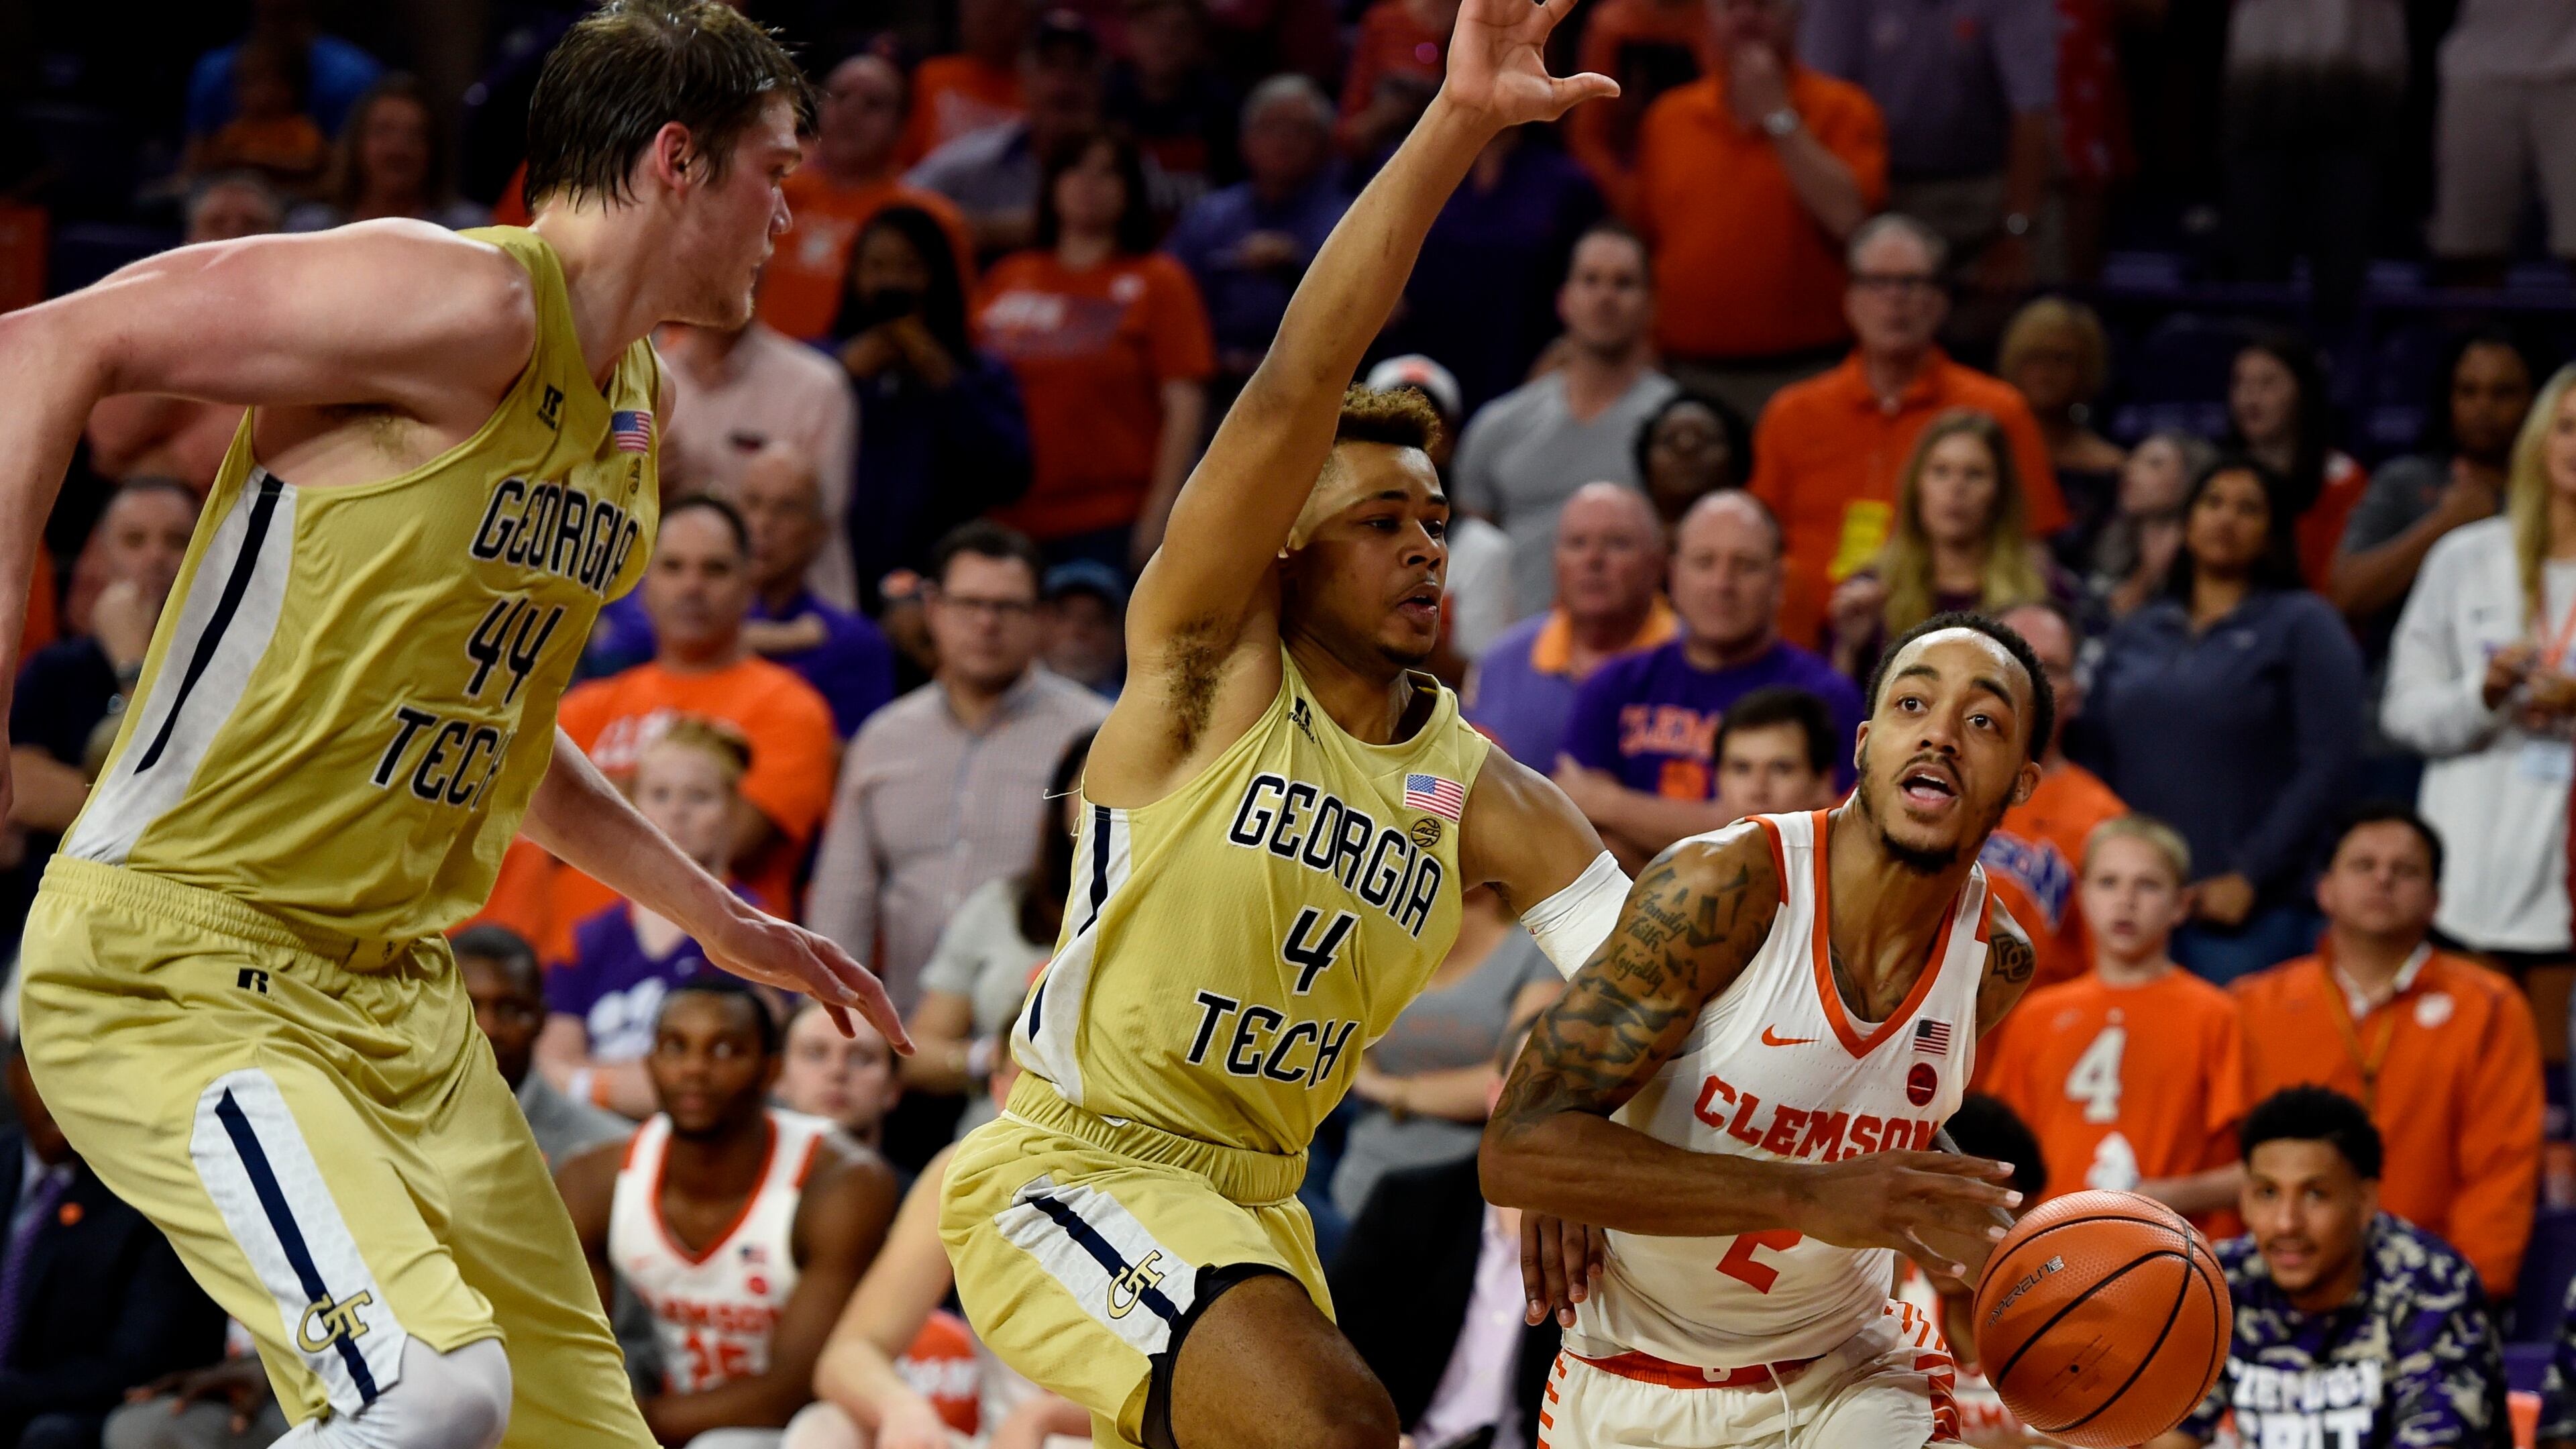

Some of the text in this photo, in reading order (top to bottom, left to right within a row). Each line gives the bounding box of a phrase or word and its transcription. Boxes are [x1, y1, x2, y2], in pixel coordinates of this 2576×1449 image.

[468, 477, 639, 598] GEORGIA
[465, 594, 567, 709] 44
[1226, 771, 1442, 941] GEORGIA
[1280, 904, 1362, 997] 4
[1185, 988, 1361, 1090] TECH
[2063, 1025, 2128, 1124] 4
[1694, 1075, 1939, 1163] CLEMSON
[1988, 1255, 2065, 1329] HYPERELITE
